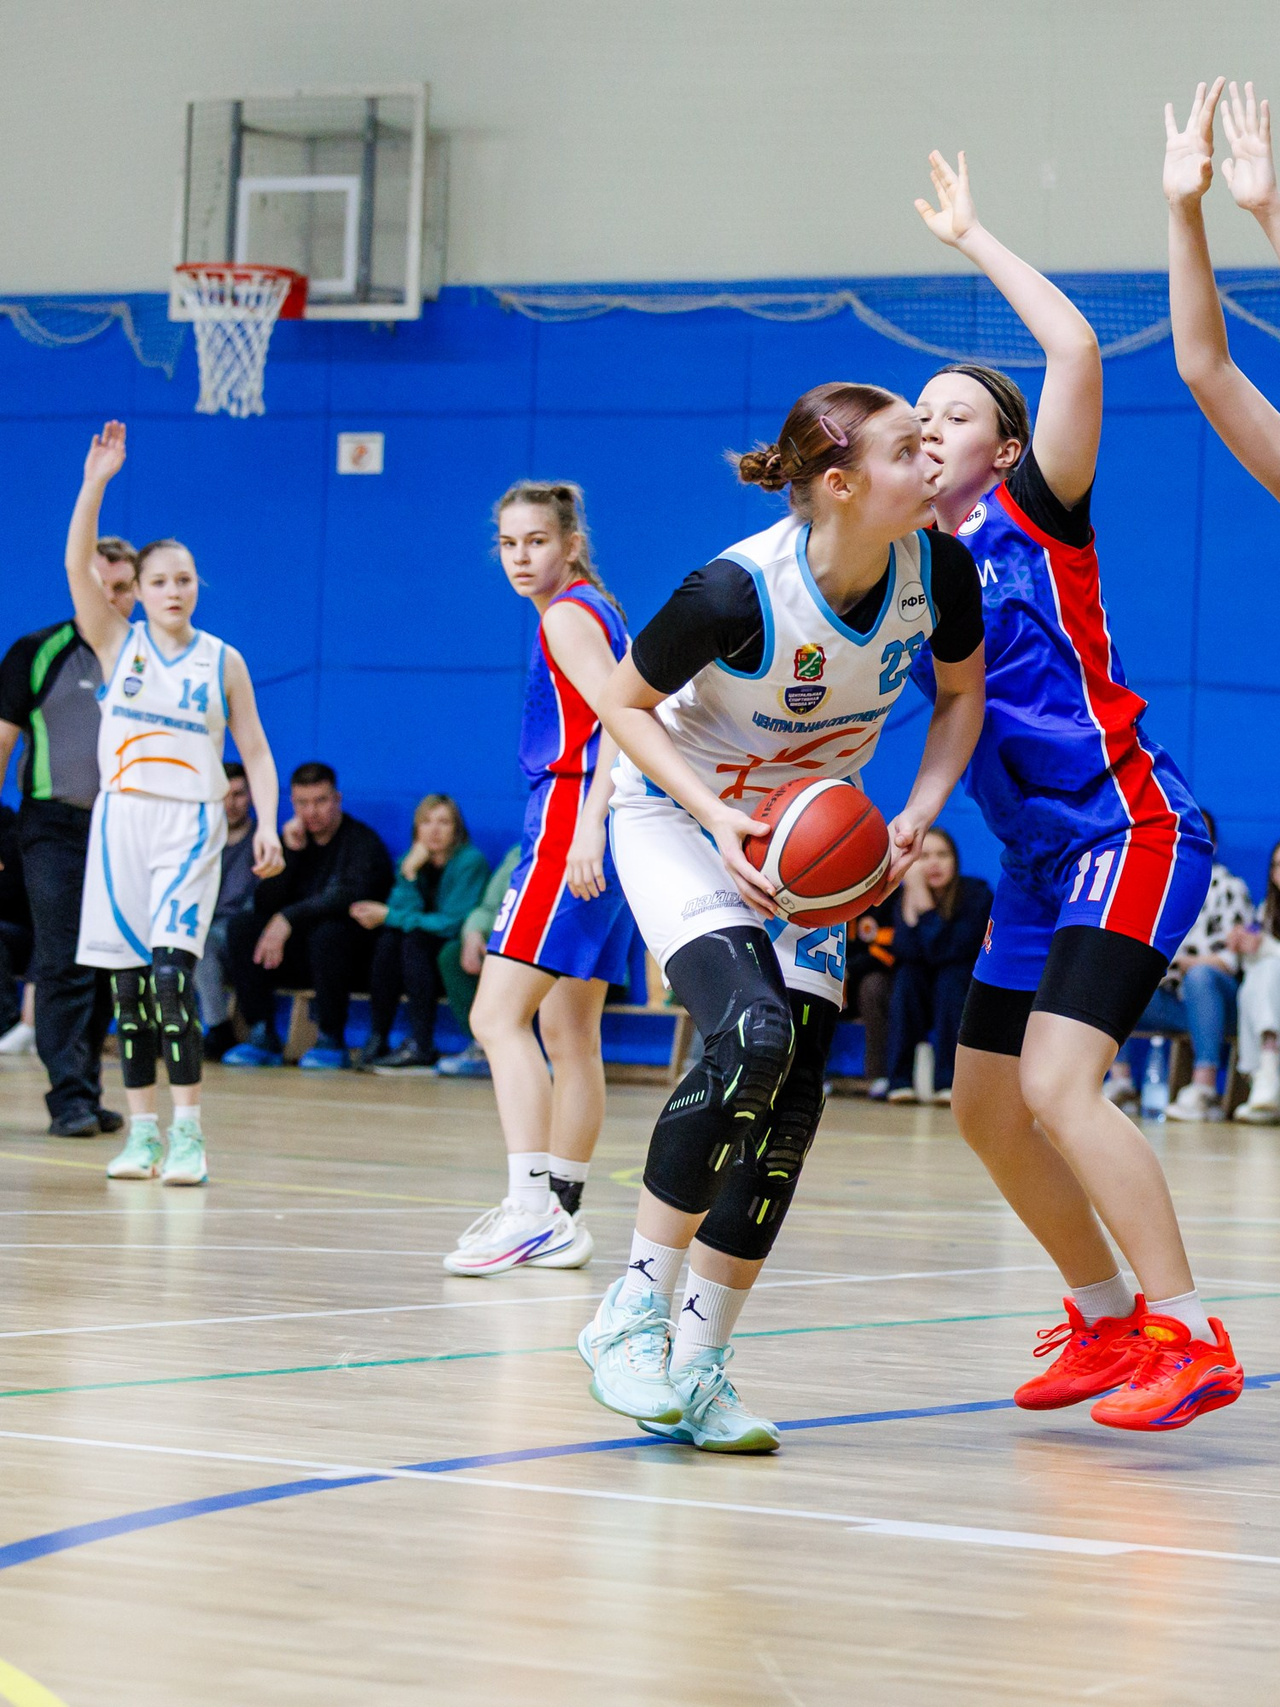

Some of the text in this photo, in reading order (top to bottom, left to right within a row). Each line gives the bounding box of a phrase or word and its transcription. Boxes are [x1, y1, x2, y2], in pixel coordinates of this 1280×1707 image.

[901, 593, 926, 611] РФБ
[178, 678, 208, 713] 14
[1068, 849, 1115, 903] 11
[165, 899, 199, 938] 14
